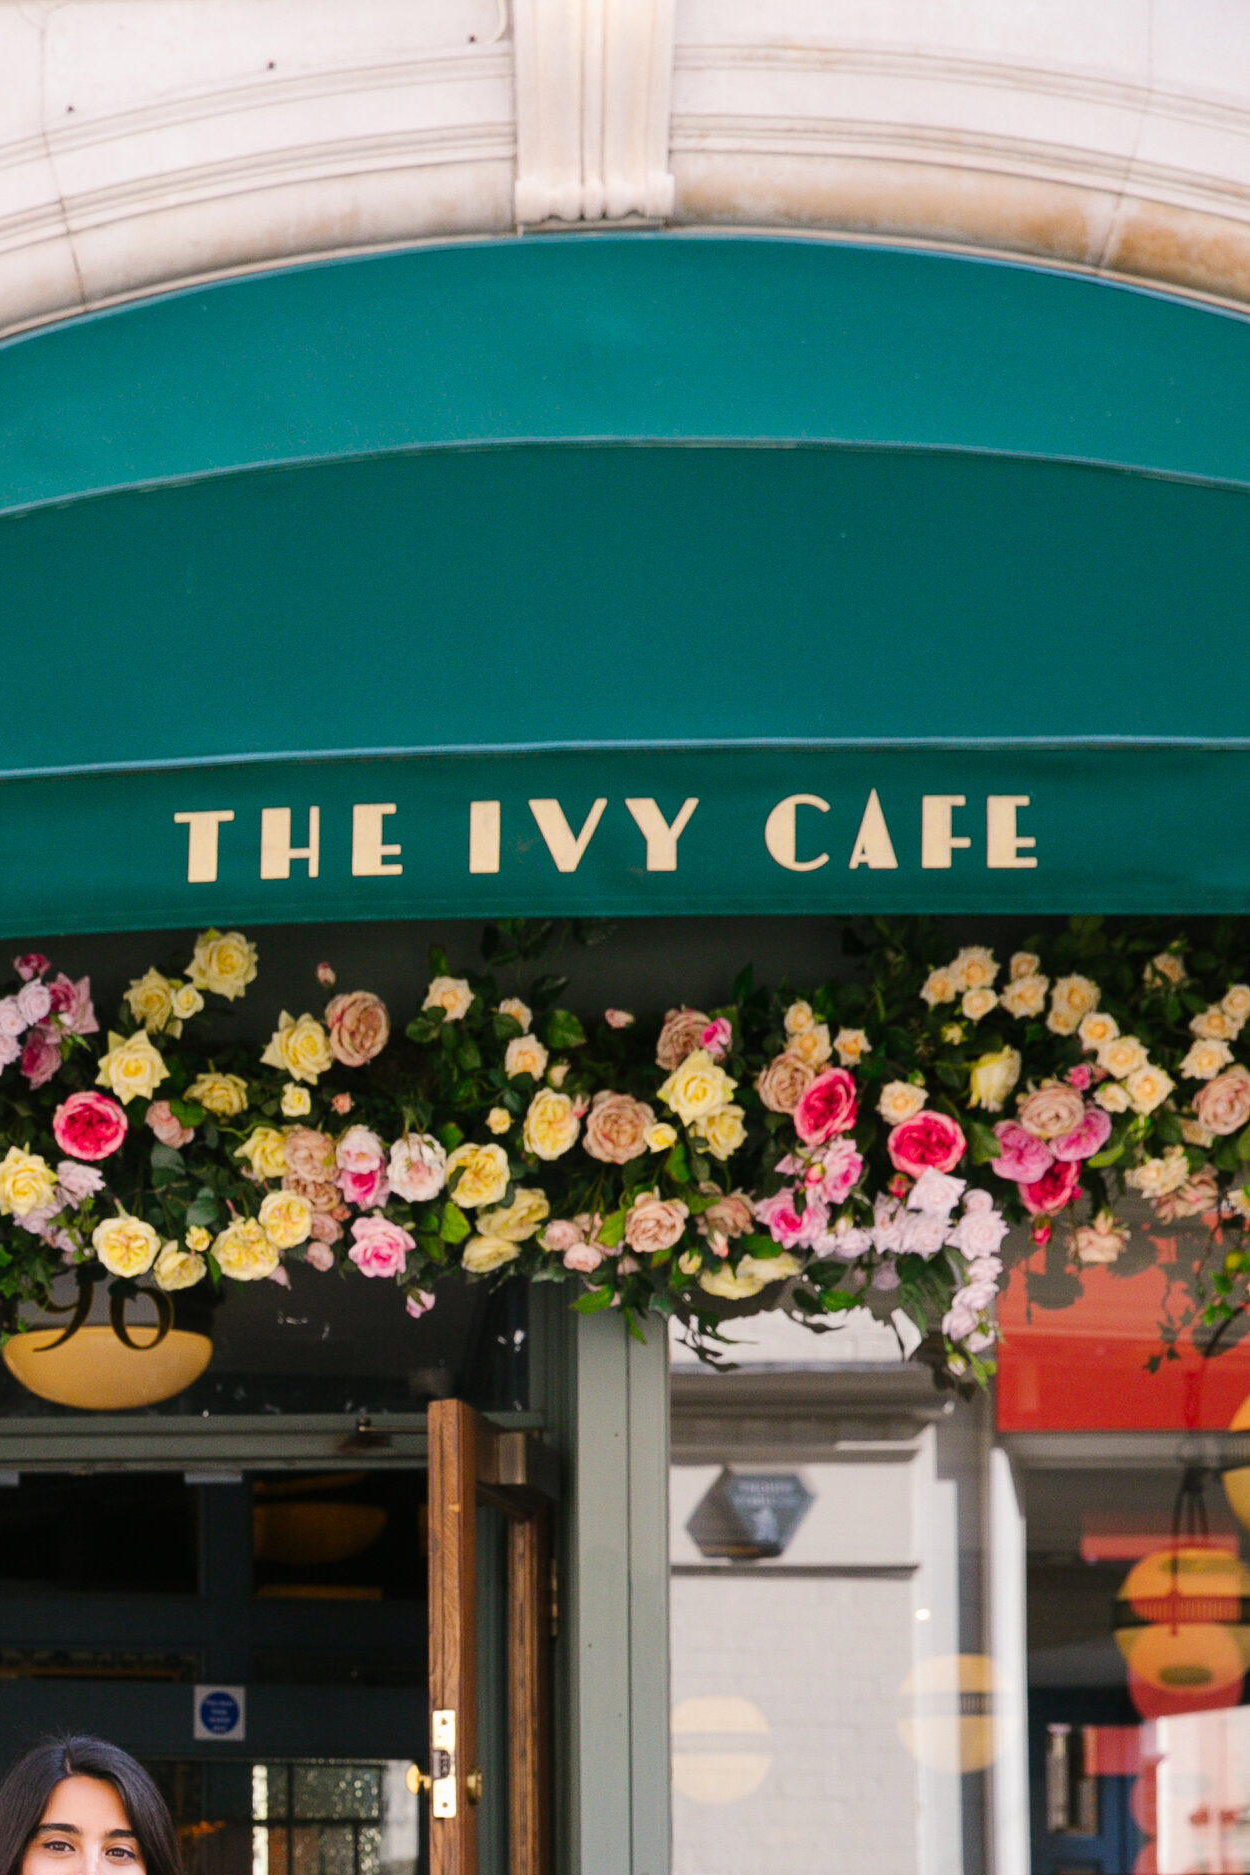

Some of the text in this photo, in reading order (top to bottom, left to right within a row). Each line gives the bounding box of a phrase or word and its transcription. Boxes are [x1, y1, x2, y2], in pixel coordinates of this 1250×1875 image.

[173, 788, 1038, 884] THE IVY CAFE
